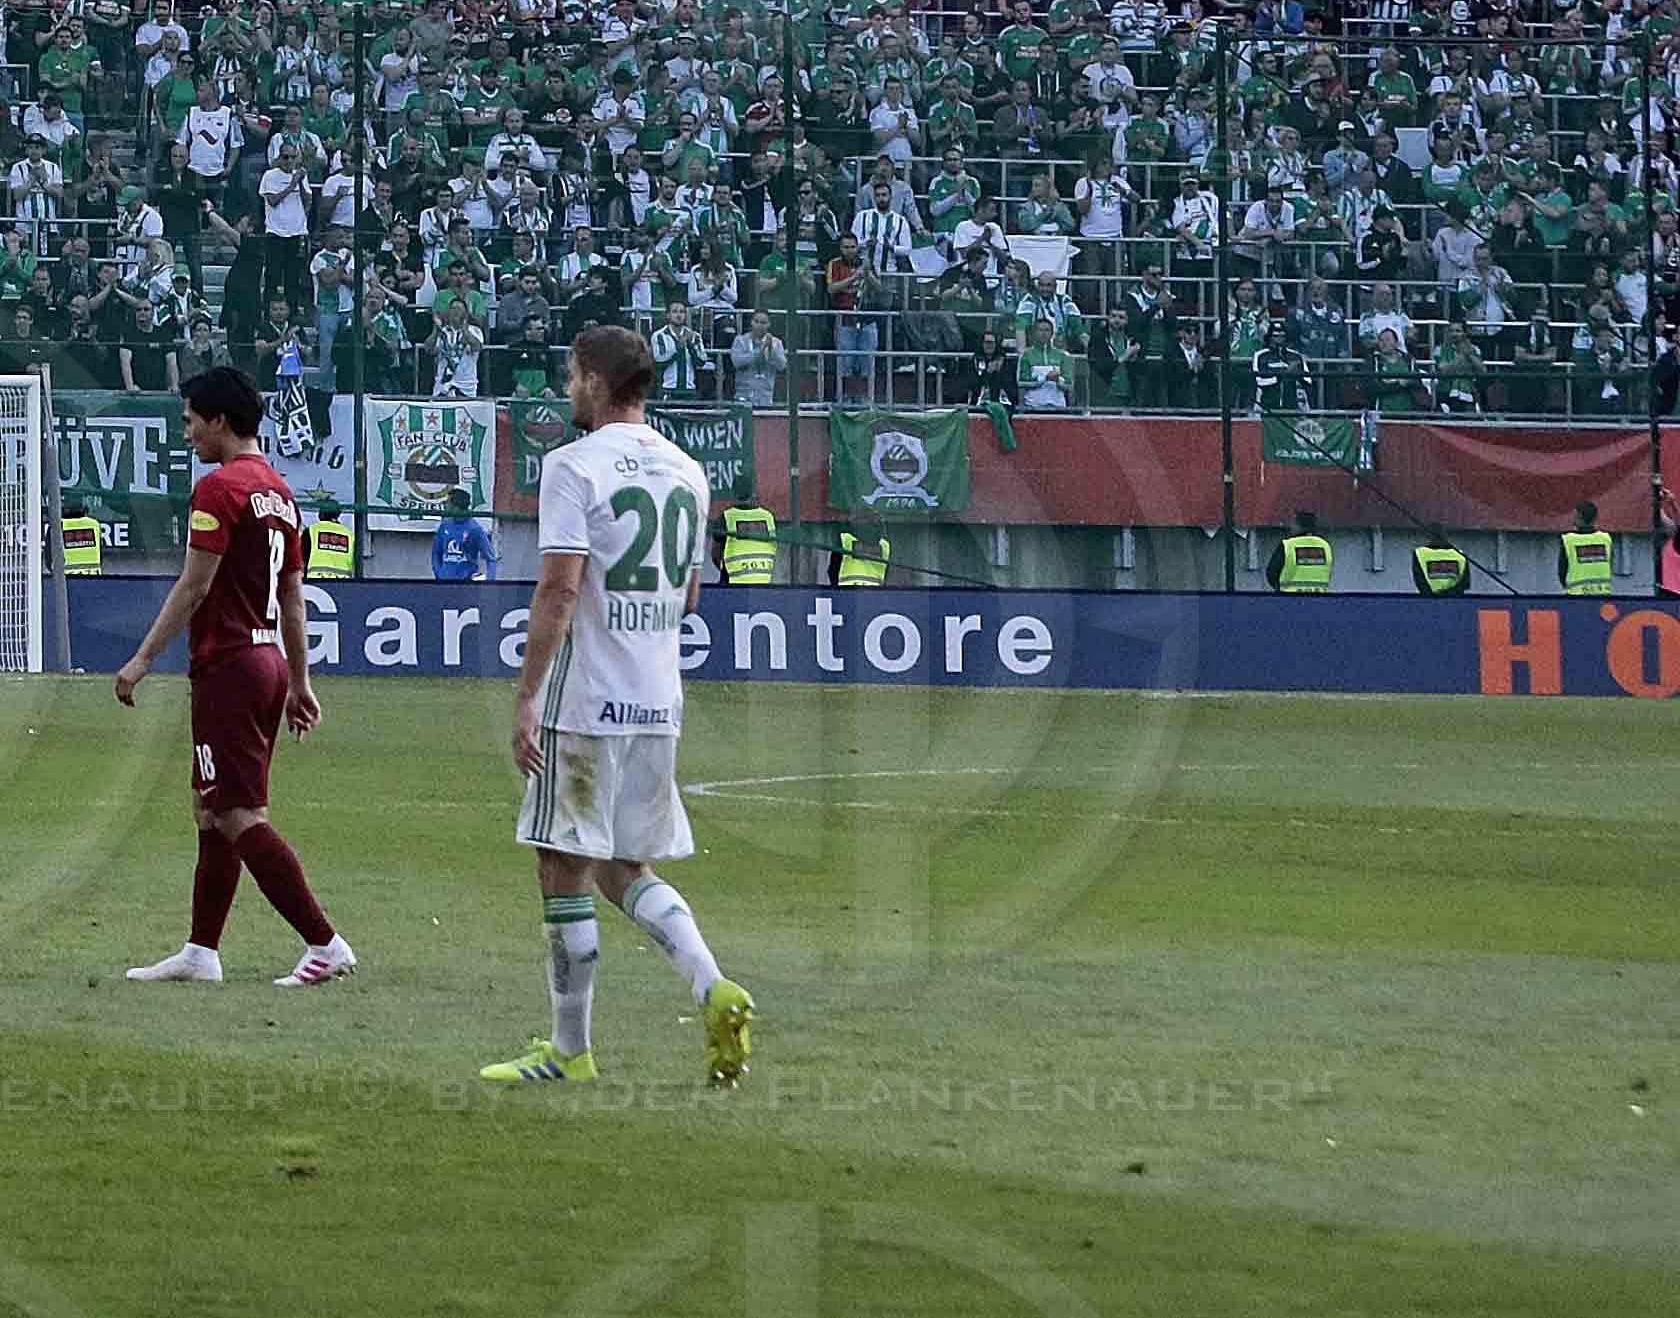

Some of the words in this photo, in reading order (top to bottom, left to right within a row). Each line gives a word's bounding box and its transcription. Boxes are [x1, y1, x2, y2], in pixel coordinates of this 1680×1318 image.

[395, 431, 426, 448] FAN
[433, 430, 469, 451] CLUB
[605, 485, 699, 592] 20
[599, 700, 671, 725] Allianz
[195, 743, 216, 782] 18
